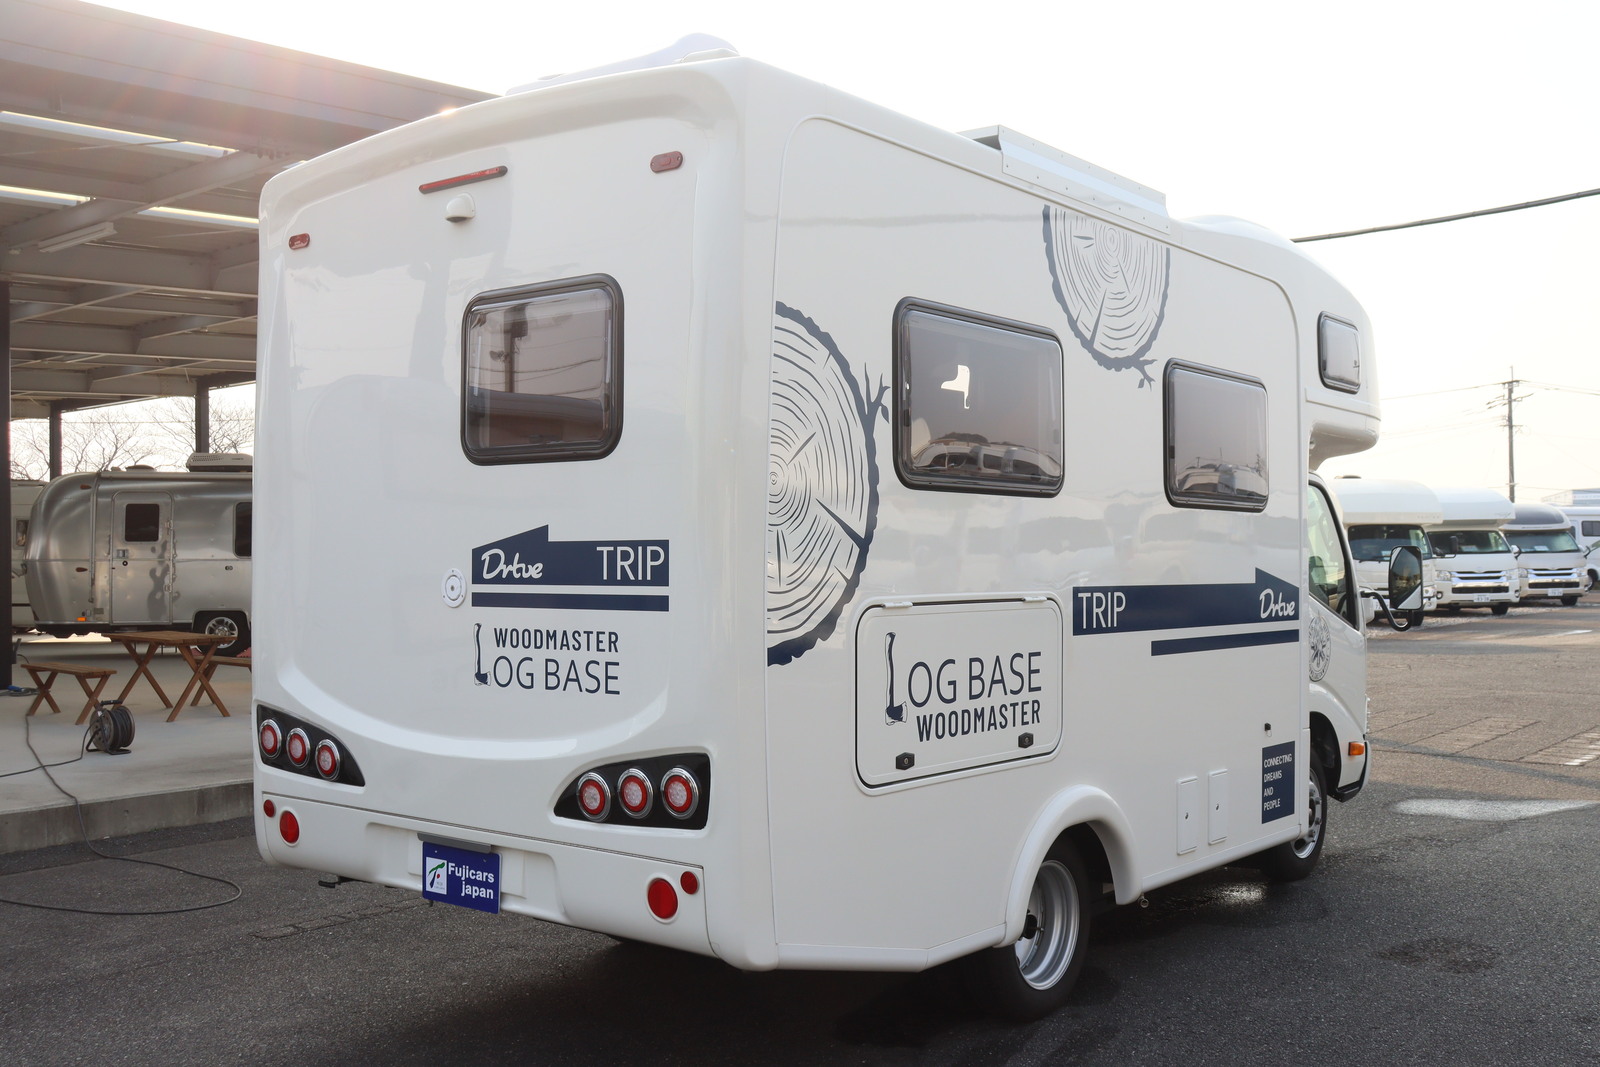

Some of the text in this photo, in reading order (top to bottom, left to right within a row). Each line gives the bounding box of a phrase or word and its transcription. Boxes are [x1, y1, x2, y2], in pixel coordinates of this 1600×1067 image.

[597, 546, 665, 581] TRIP
[1078, 591, 1126, 629] TRIP
[494, 628, 619, 653] WOODMASTER
[545, 658, 620, 695] BASE
[968, 651, 1042, 700] BASE
[916, 699, 1041, 742] WOODMASTER
[1264, 754, 1292, 768] CONNECTING
[1264, 770, 1282, 782] DREAMS
[1263, 787, 1274, 797] AND
[1263, 799, 1281, 811] PEOPLE
[448, 862, 494, 883] Fujicars
[461, 881, 493, 899] japan
